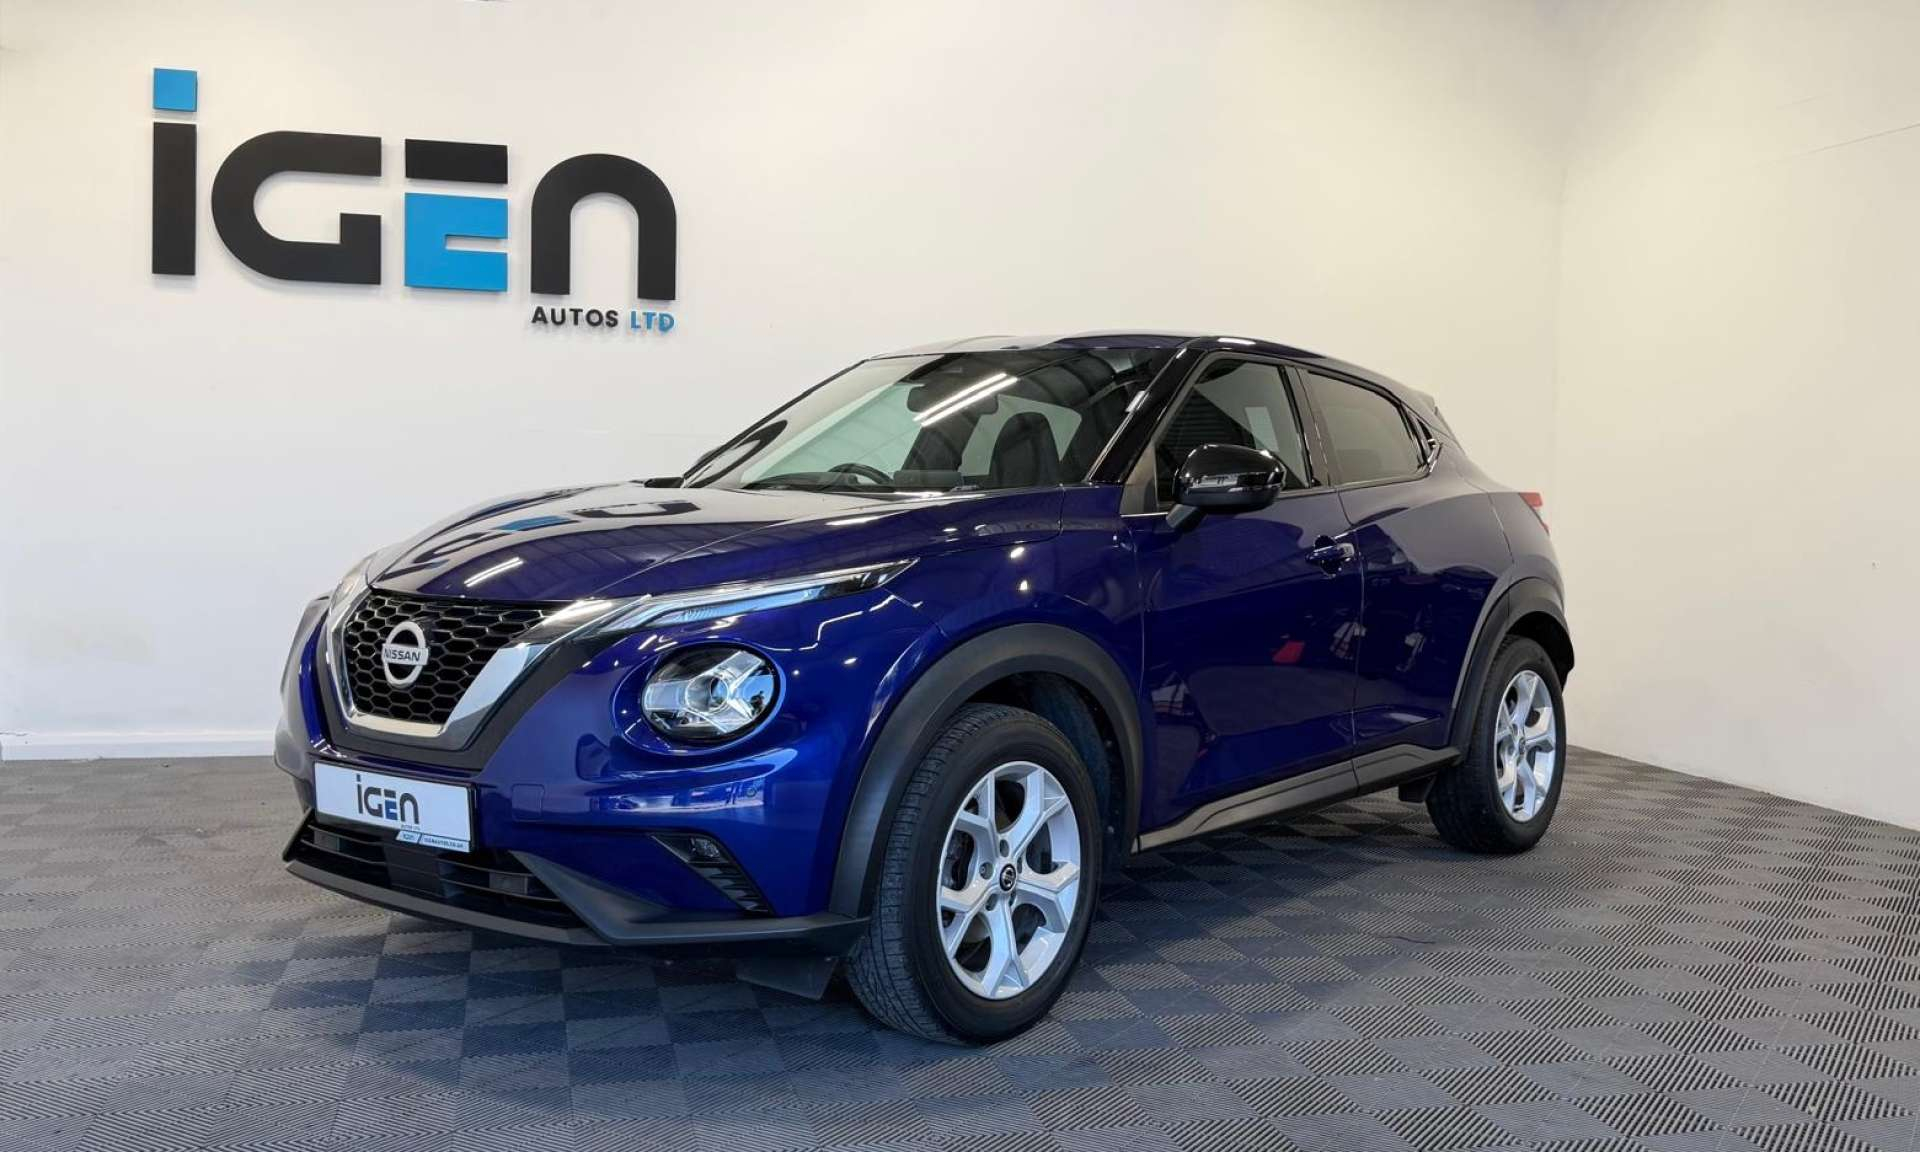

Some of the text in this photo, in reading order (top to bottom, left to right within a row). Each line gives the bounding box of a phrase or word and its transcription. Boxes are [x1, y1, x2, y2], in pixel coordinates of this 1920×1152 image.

[531, 306, 675, 332] AUTOS LTD
[384, 647, 421, 662] NISSAN
